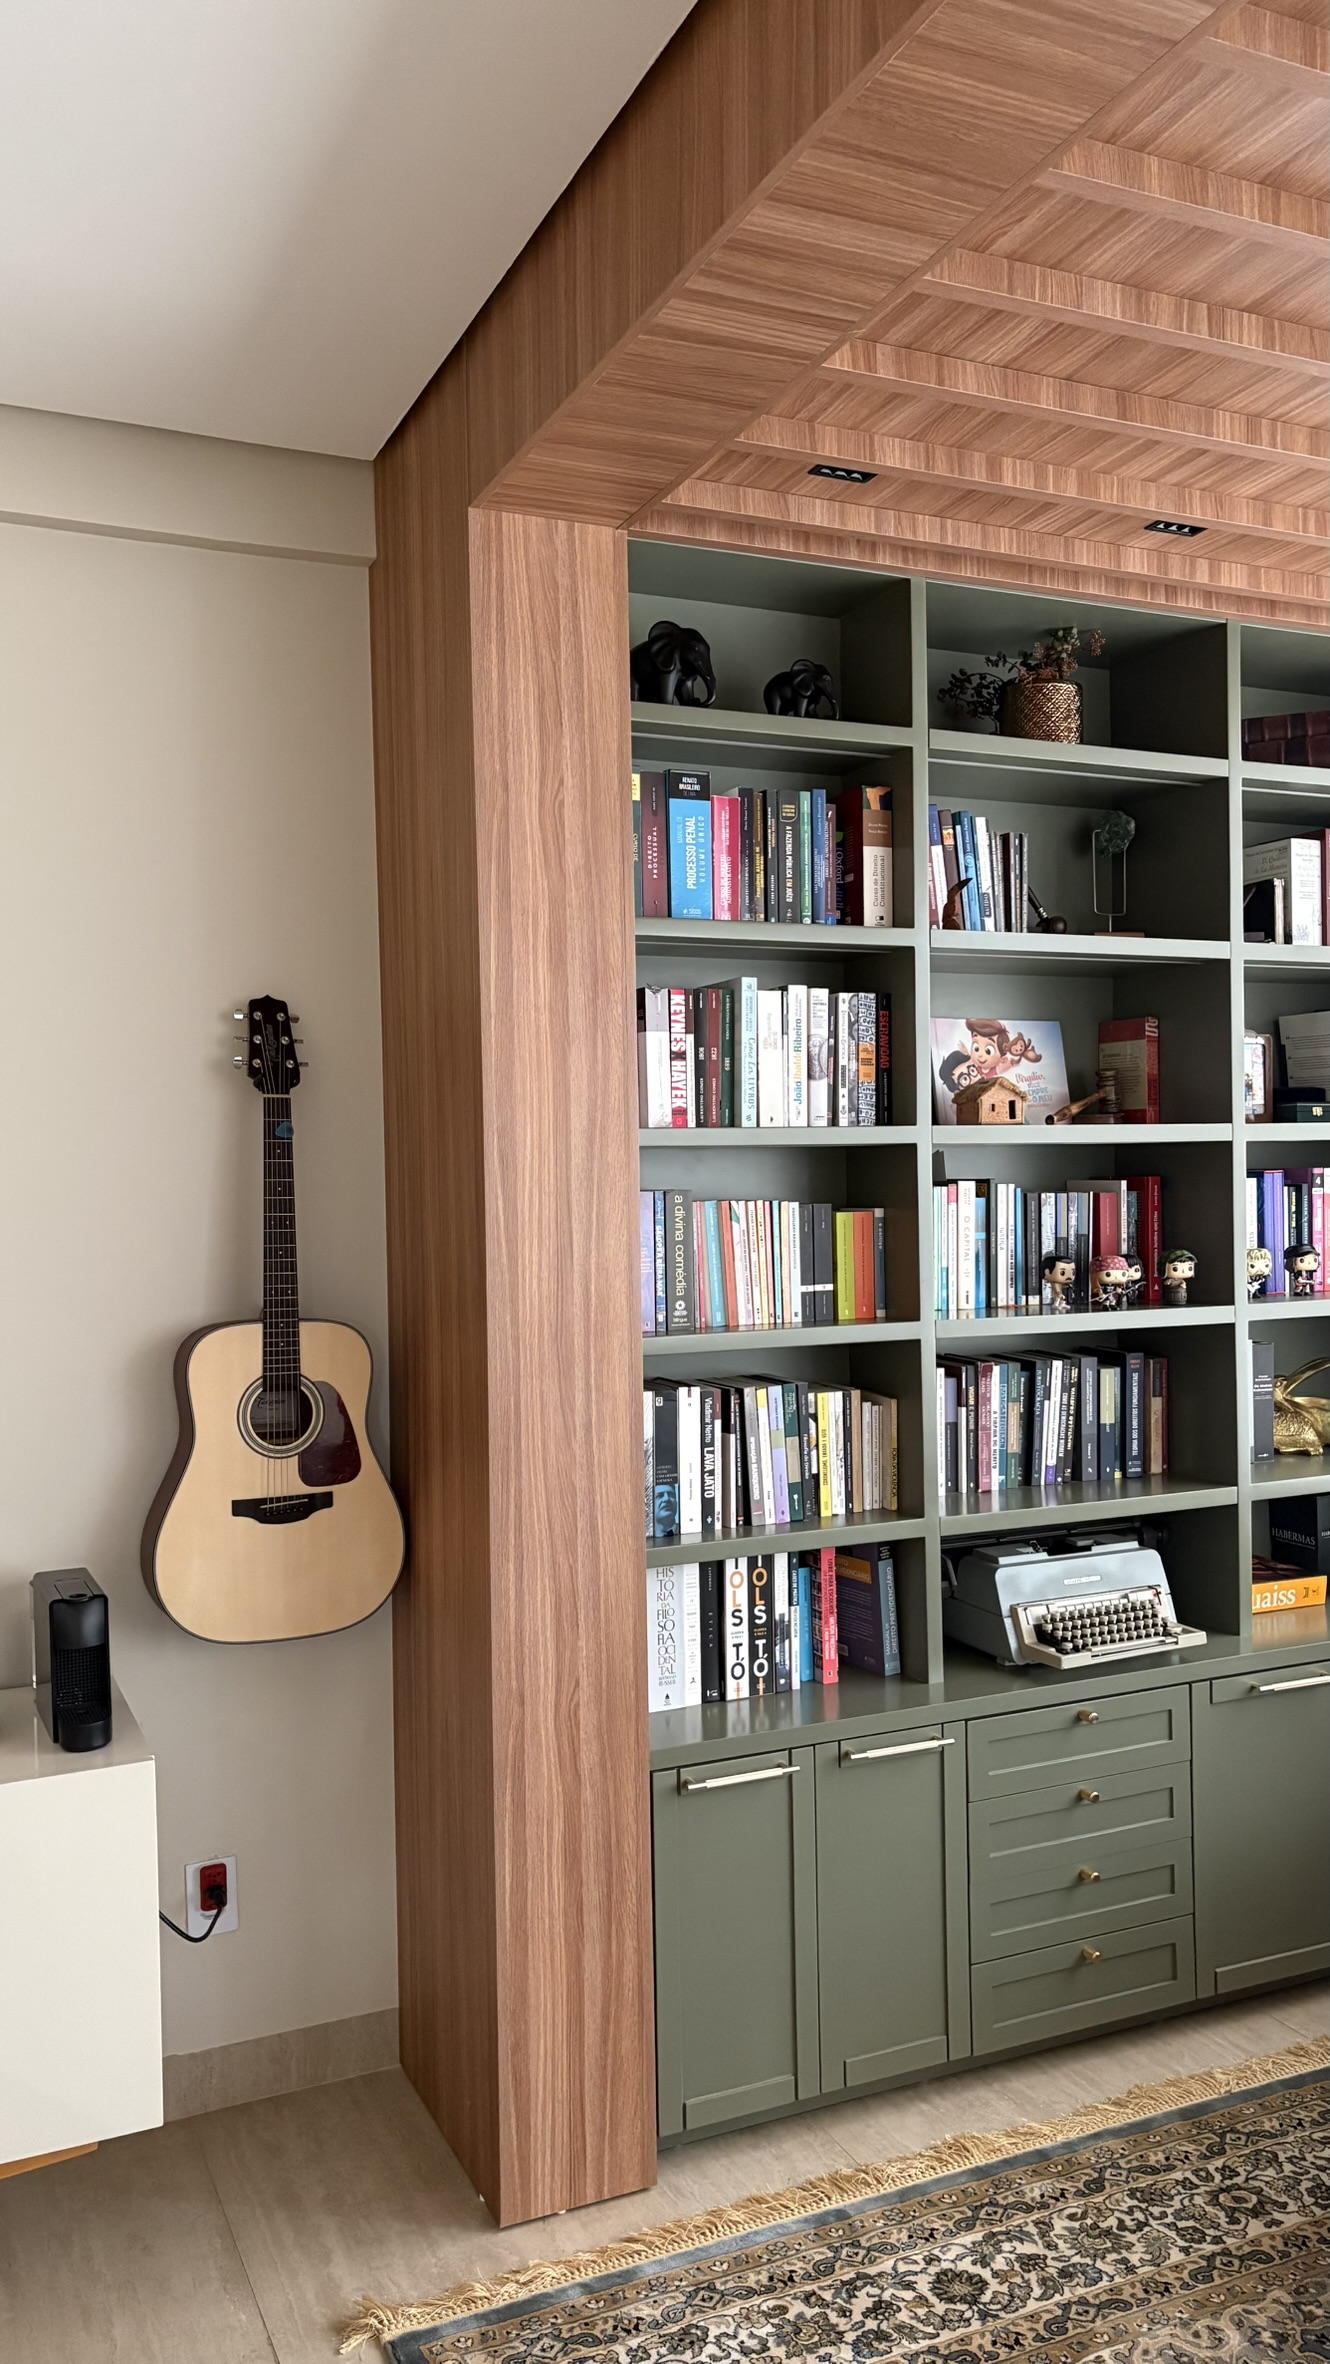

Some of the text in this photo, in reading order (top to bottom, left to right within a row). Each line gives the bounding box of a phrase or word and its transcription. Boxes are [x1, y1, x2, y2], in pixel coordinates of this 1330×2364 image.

[679, 783, 701, 791] BRASILEIRO
[685, 816, 697, 889] PROCESSO PENAL
[836, 850, 844, 884] Oxford
[873, 878, 879, 887] de
[794, 1018, 802, 1052] Ribeiro
[671, 994, 687, 1108] KEYNES HAYEK
[794, 1081, 802, 1104] João
[674, 1195, 688, 1297] a divina comédia
[704, 1397, 713, 1443] Vladimir Netto
[704, 1447, 715, 1498] LAVA JATO
[1271, 1527, 1316, 1546] HABERMAS
[656, 1567, 675, 1579] HIS
[656, 1591, 675, 1602] RIA
[657, 1619, 675, 1633] SO
[658, 1654, 676, 1666] DEN
[658, 1664, 676, 1676] TAL
